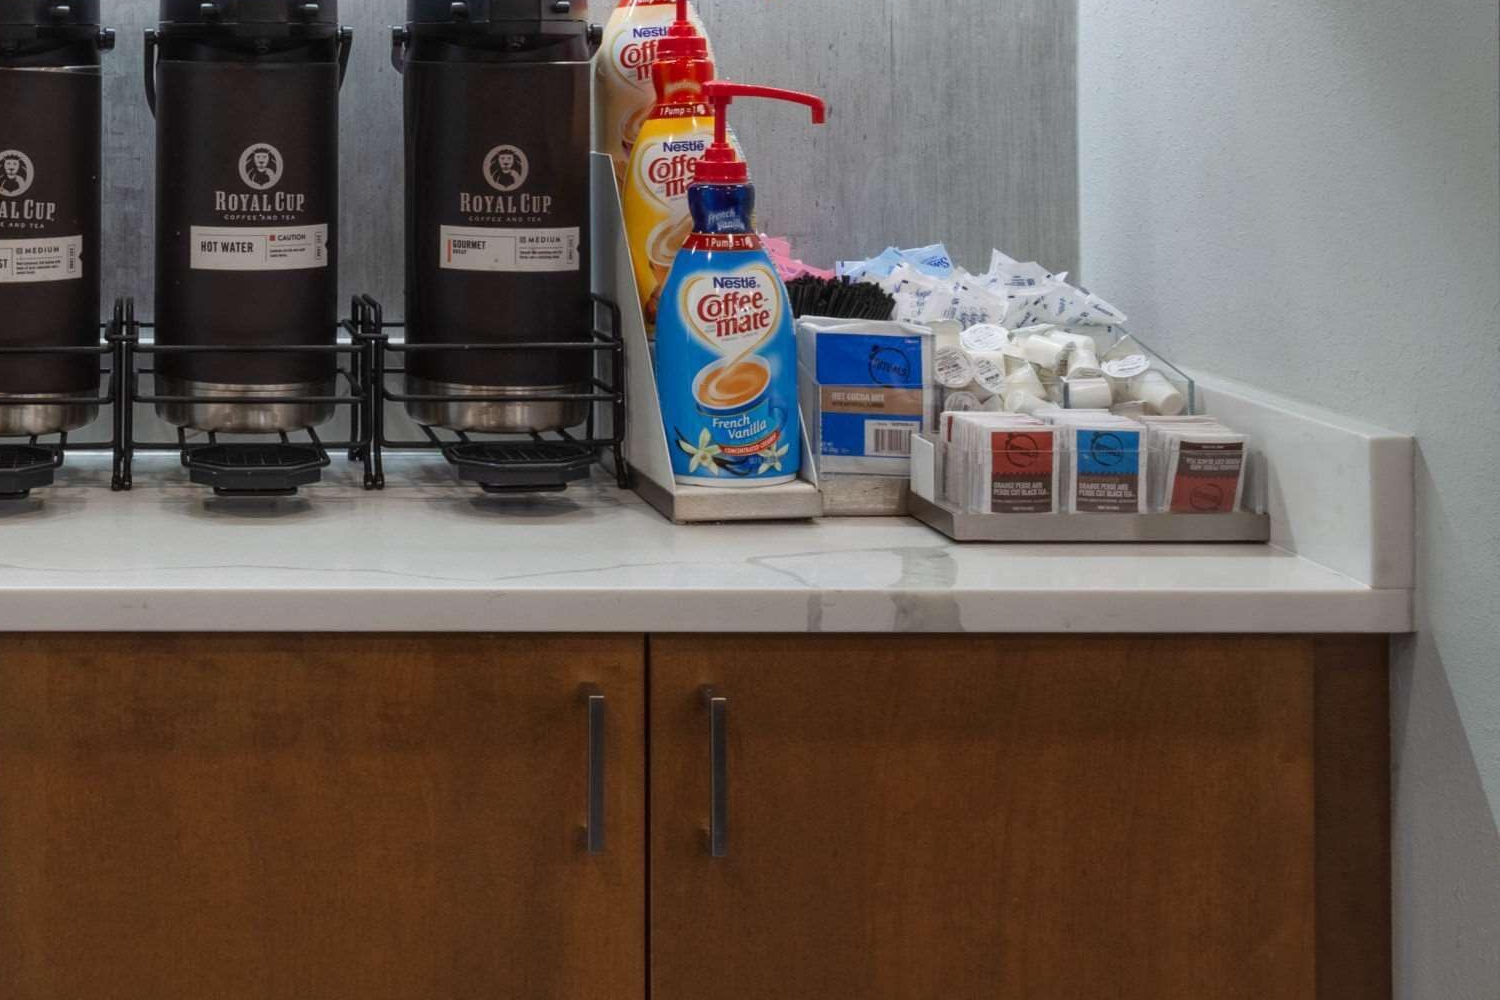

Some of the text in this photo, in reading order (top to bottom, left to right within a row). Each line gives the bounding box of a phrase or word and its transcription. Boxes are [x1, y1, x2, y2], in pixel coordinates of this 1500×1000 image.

[633, 27, 667, 38] Nestl
[620, 40, 657, 69] Coff
[664, 107, 685, 116] Pump
[648, 154, 705, 184] Coffe
[215, 190, 305, 212] ROYAL CUP
[460, 192, 552, 214] ROYAL CUP
[23, 199, 56, 221] CUP
[277, 233, 306, 241] CAUTION
[528, 236, 561, 244] MEDIUM
[711, 237, 733, 249] Pump
[25, 246, 60, 255] MEDIUM
[200, 240, 254, 253] HOT WATER
[452, 239, 486, 250] GOURMET
[713, 276, 757, 289] Nestlé
[716, 310, 770, 337] mate
[712, 414, 750, 429] French
[728, 419, 767, 439] Vanilla
